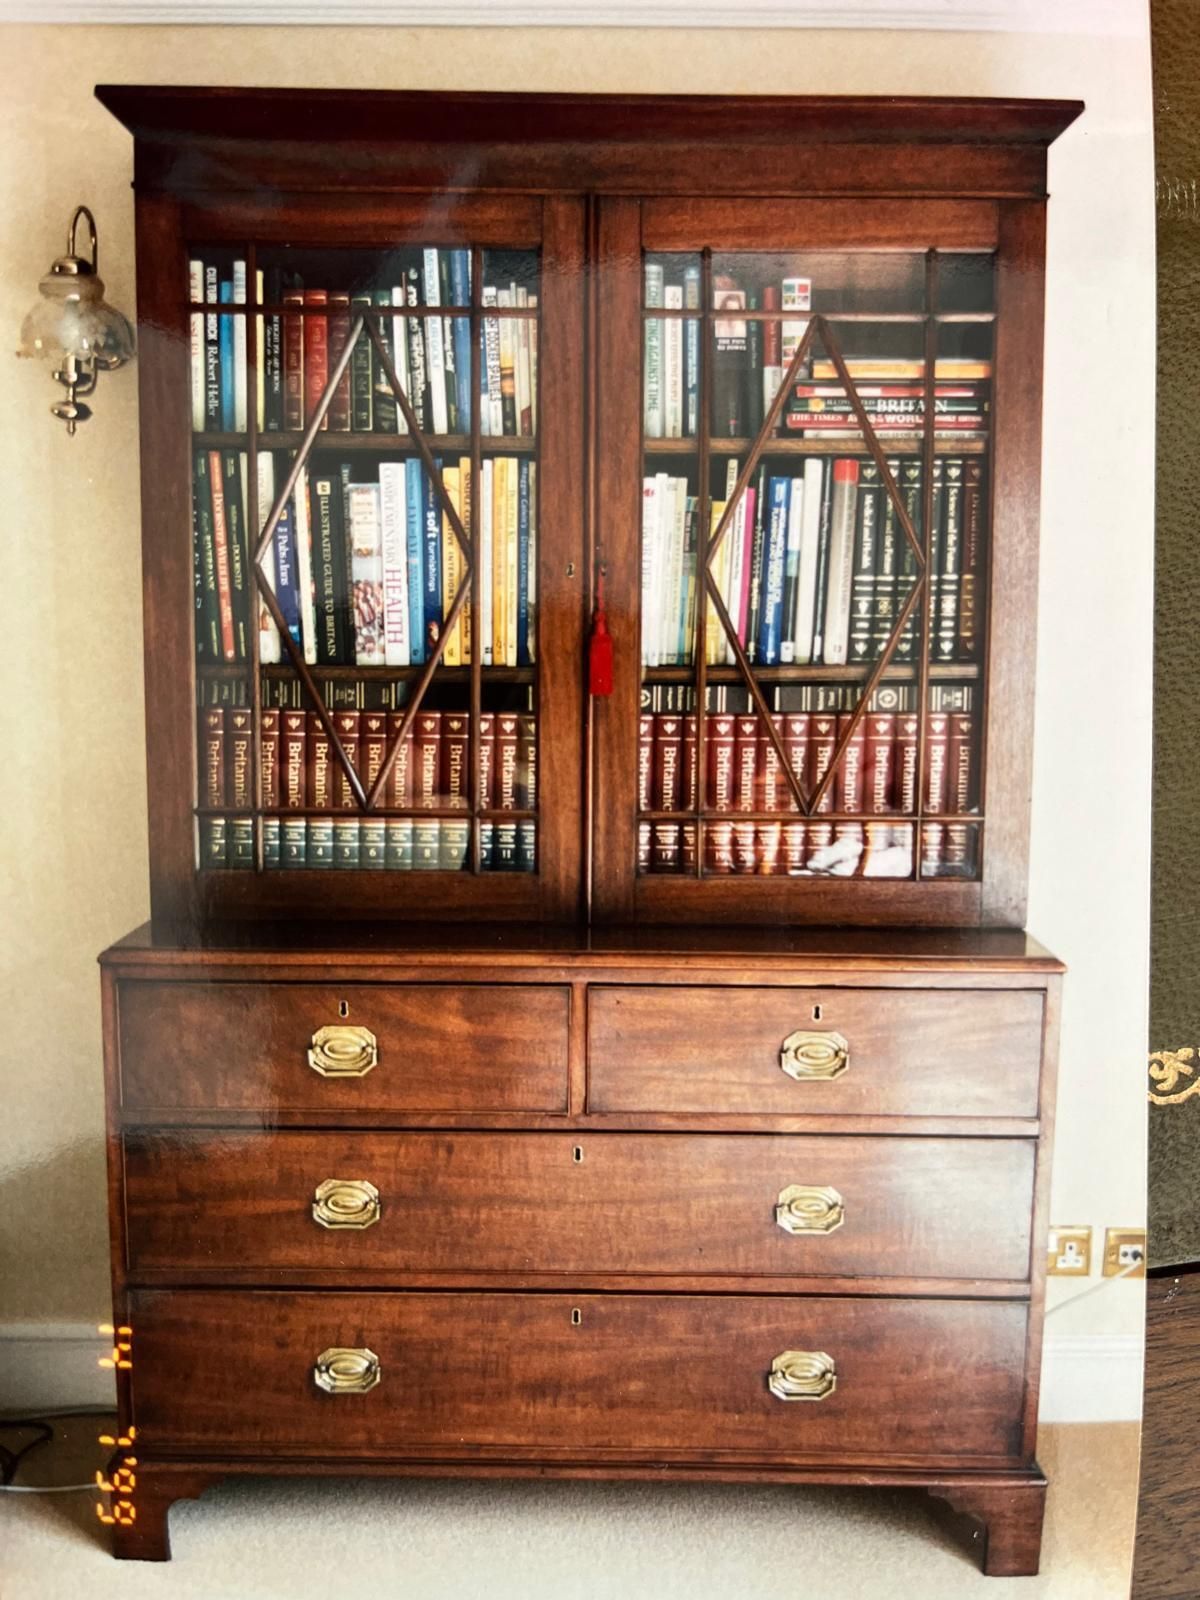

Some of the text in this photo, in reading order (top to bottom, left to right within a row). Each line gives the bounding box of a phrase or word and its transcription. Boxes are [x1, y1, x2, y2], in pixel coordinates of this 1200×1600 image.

[206, 267, 217, 304] CULTUR
[647, 284, 660, 342] COMTING
[207, 346, 219, 381] Robert
[647, 344, 660, 385] AGAINST
[207, 384, 220, 416] Heller
[647, 388, 660, 412] TIME
[877, 398, 948, 412] BRITAN
[884, 414, 924, 424] WORL
[278, 534, 288, 558] Pubs
[320, 496, 332, 561] ILLUSTRATED
[383, 466, 404, 645] COMPLEMENTARY HEALTH
[426, 510, 438, 539] soft
[861, 494, 873, 569] Medical and Health
[946, 488, 959, 573] Science and the Future
[279, 564, 289, 586] Inns
[323, 564, 334, 597] GUIDE
[427, 540, 437, 593] furnishings
[447, 551, 455, 601] INTERIORS
[883, 549, 894, 574] Future
[326, 599, 334, 613] TO
[326, 615, 337, 656] BRITAIN
[208, 740, 219, 808] Britannic
[234, 740, 247, 808] Britannic
[262, 741, 275, 808] Britannic
[288, 742, 301, 808] Britannic
[315, 743, 328, 808] Britannic
[395, 743, 409, 808] Britannic
[423, 744, 436, 809] Britannic
[450, 744, 463, 809] Britannic
[502, 745, 515, 810] Britannic
[662, 746, 676, 812] Britannic
[716, 746, 731, 812] Britannic
[741, 746, 755, 812] Britannic
[765, 746, 779, 812] Britannic
[844, 746, 860, 813] Britannic
[874, 745, 890, 813] Britannic
[903, 746, 917, 813] Britannic
[929, 745, 946, 814] Britannic
